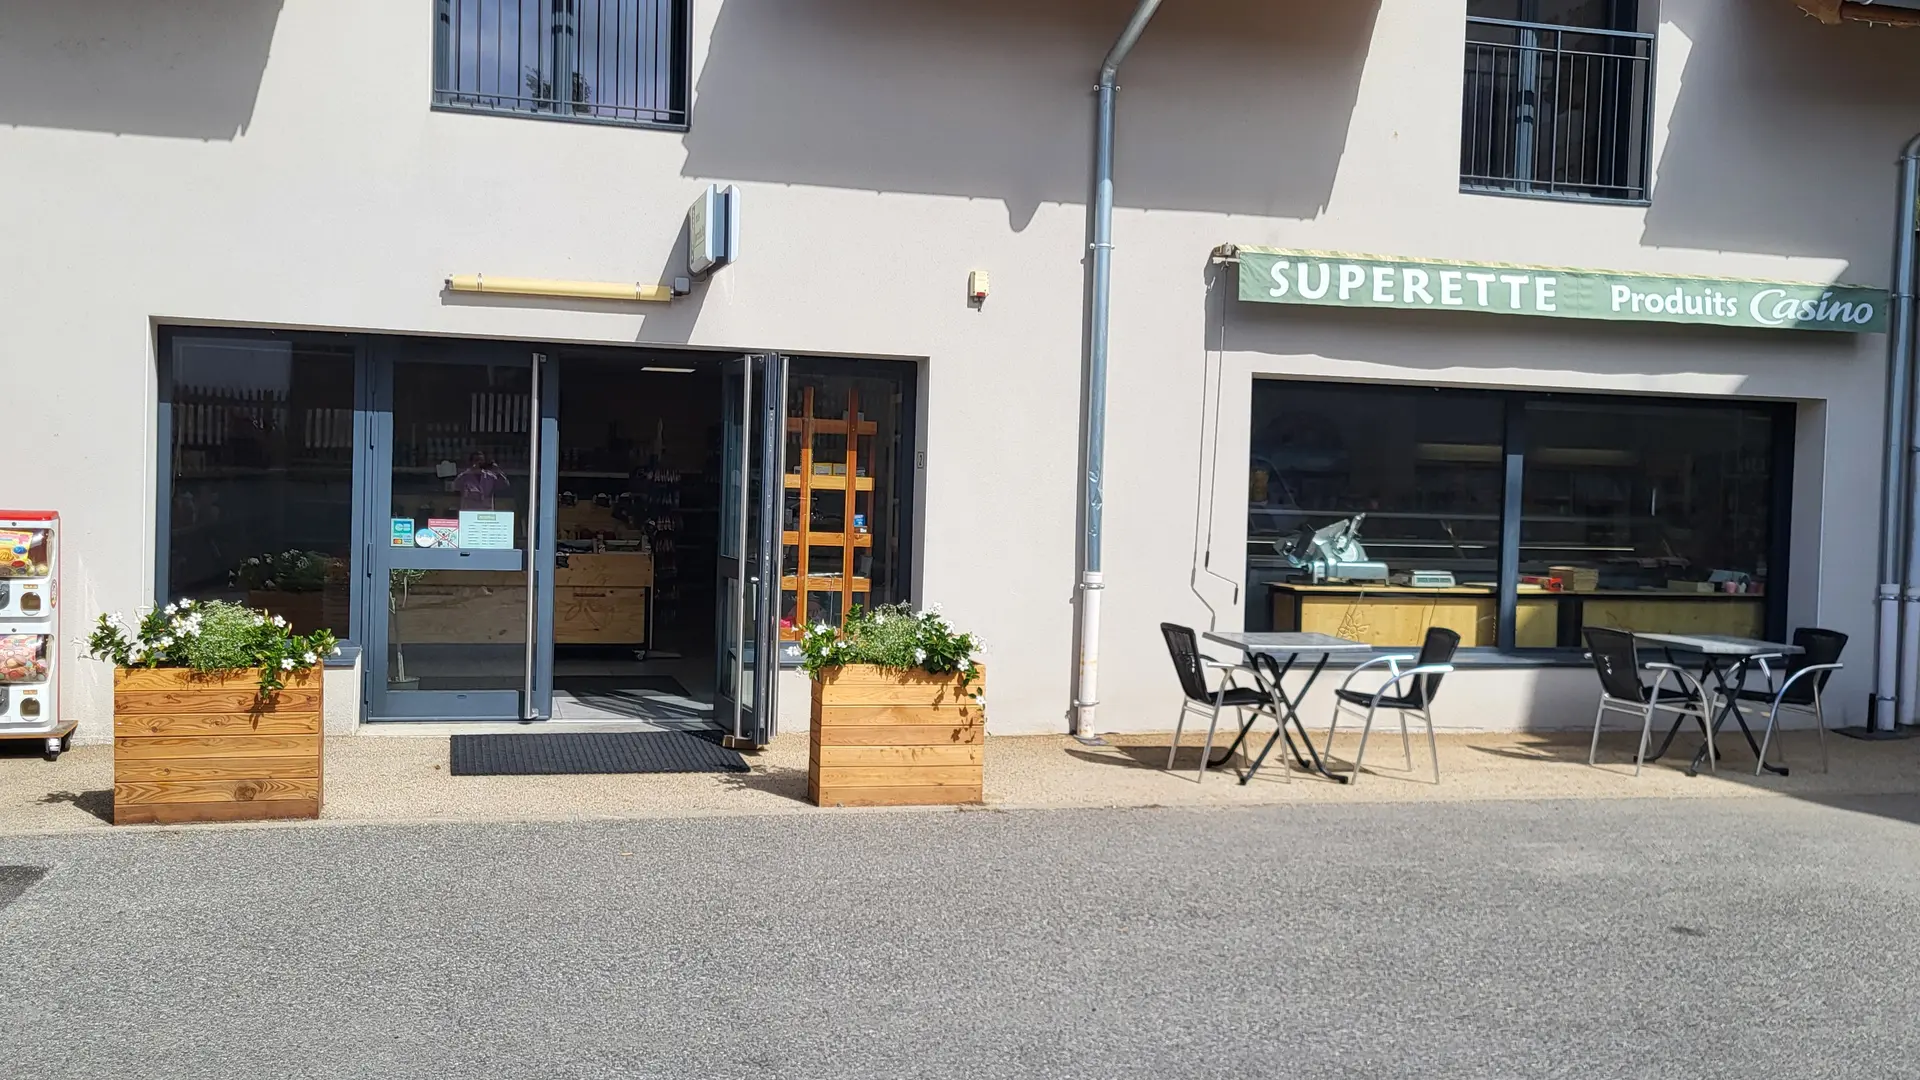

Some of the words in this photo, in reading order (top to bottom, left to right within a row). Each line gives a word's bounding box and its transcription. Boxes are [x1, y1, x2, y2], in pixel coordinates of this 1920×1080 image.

[1268, 259, 1557, 312] SUPERETTE
[1610, 283, 1738, 317] Produits
[1749, 288, 1874, 325] Casino
